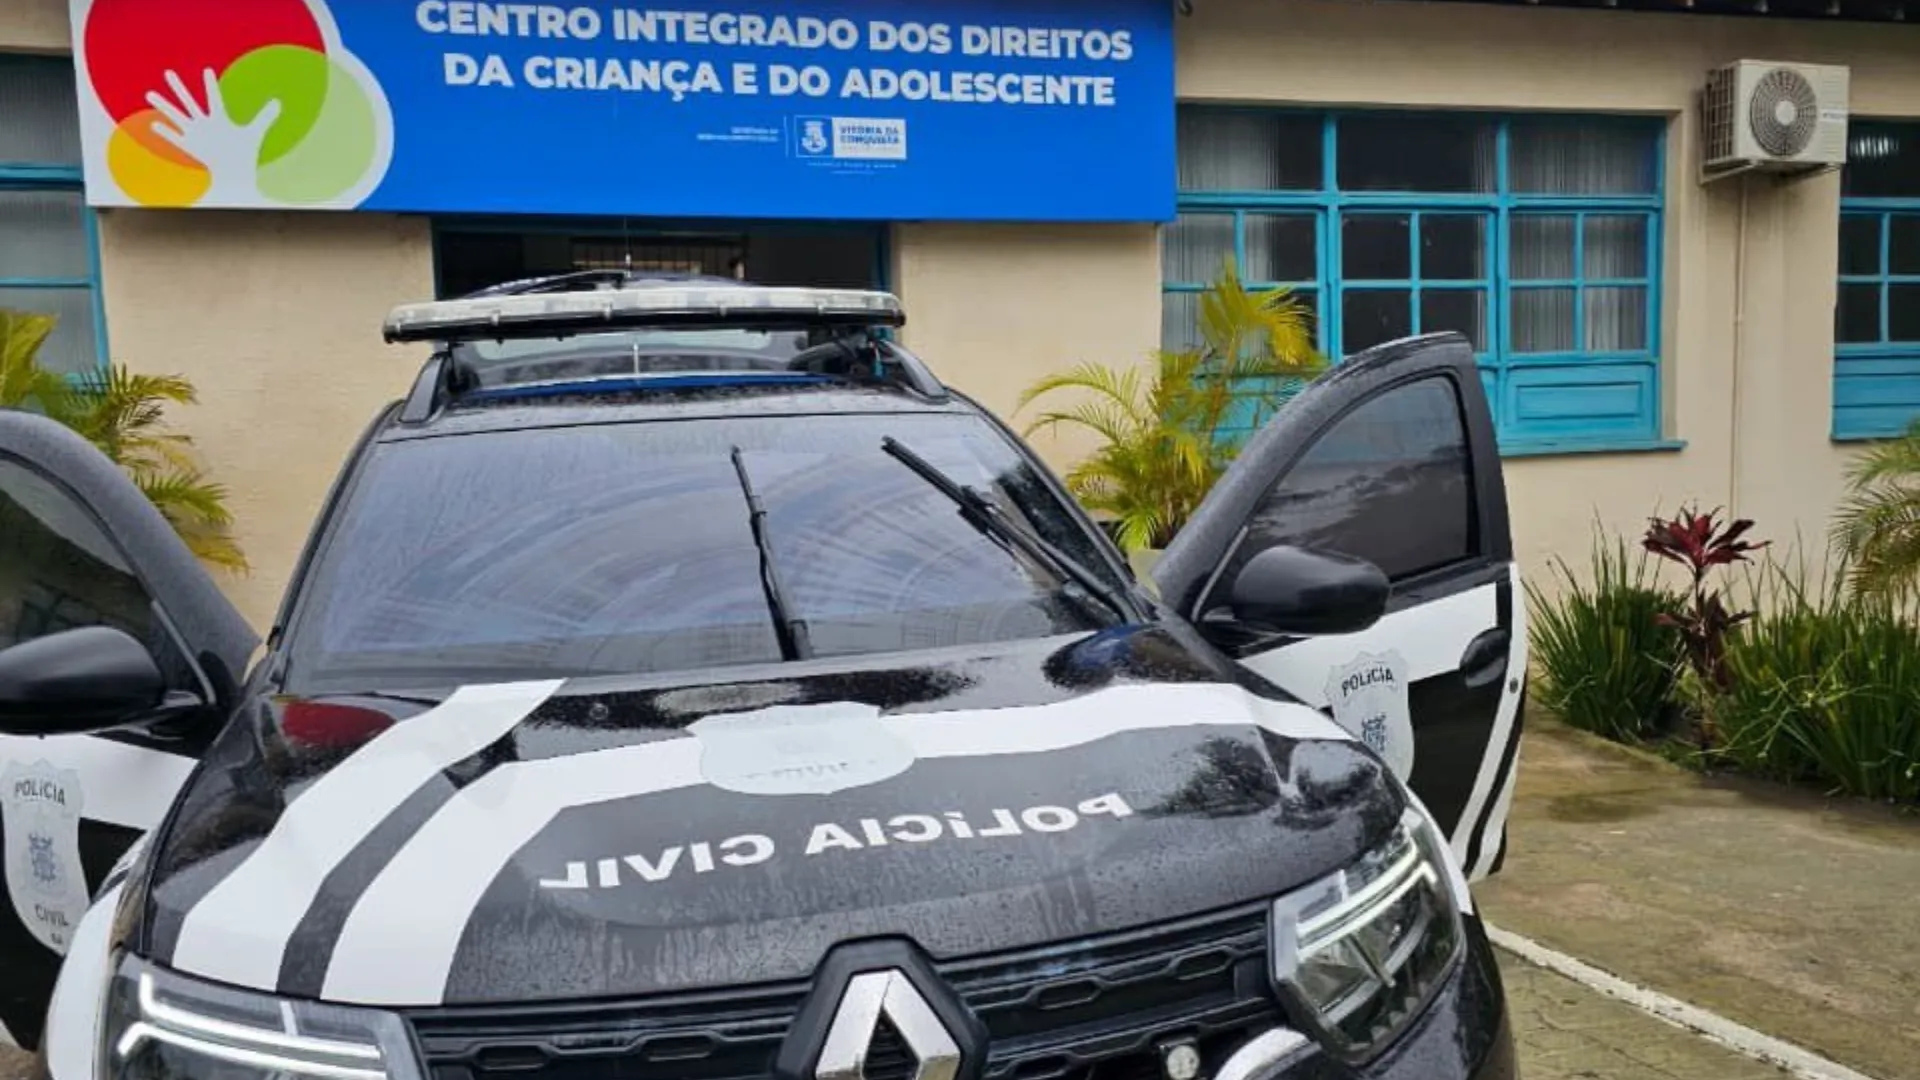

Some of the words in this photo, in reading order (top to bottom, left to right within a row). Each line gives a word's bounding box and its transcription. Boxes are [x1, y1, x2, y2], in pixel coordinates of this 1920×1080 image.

[415, 0, 601, 40] CENTRO
[613, 8, 859, 50] INTEGRADO
[869, 20, 952, 54] DOS
[961, 25, 1134, 61] DIREITOS
[443, 52, 514, 86] DA
[523, 55, 723, 102] CRIANÇA
[732, 62, 759, 95] E
[768, 64, 831, 96] DO
[840, 68, 1116, 105] ADOLESCENTE
[34, 903, 70, 927] CIVIL
